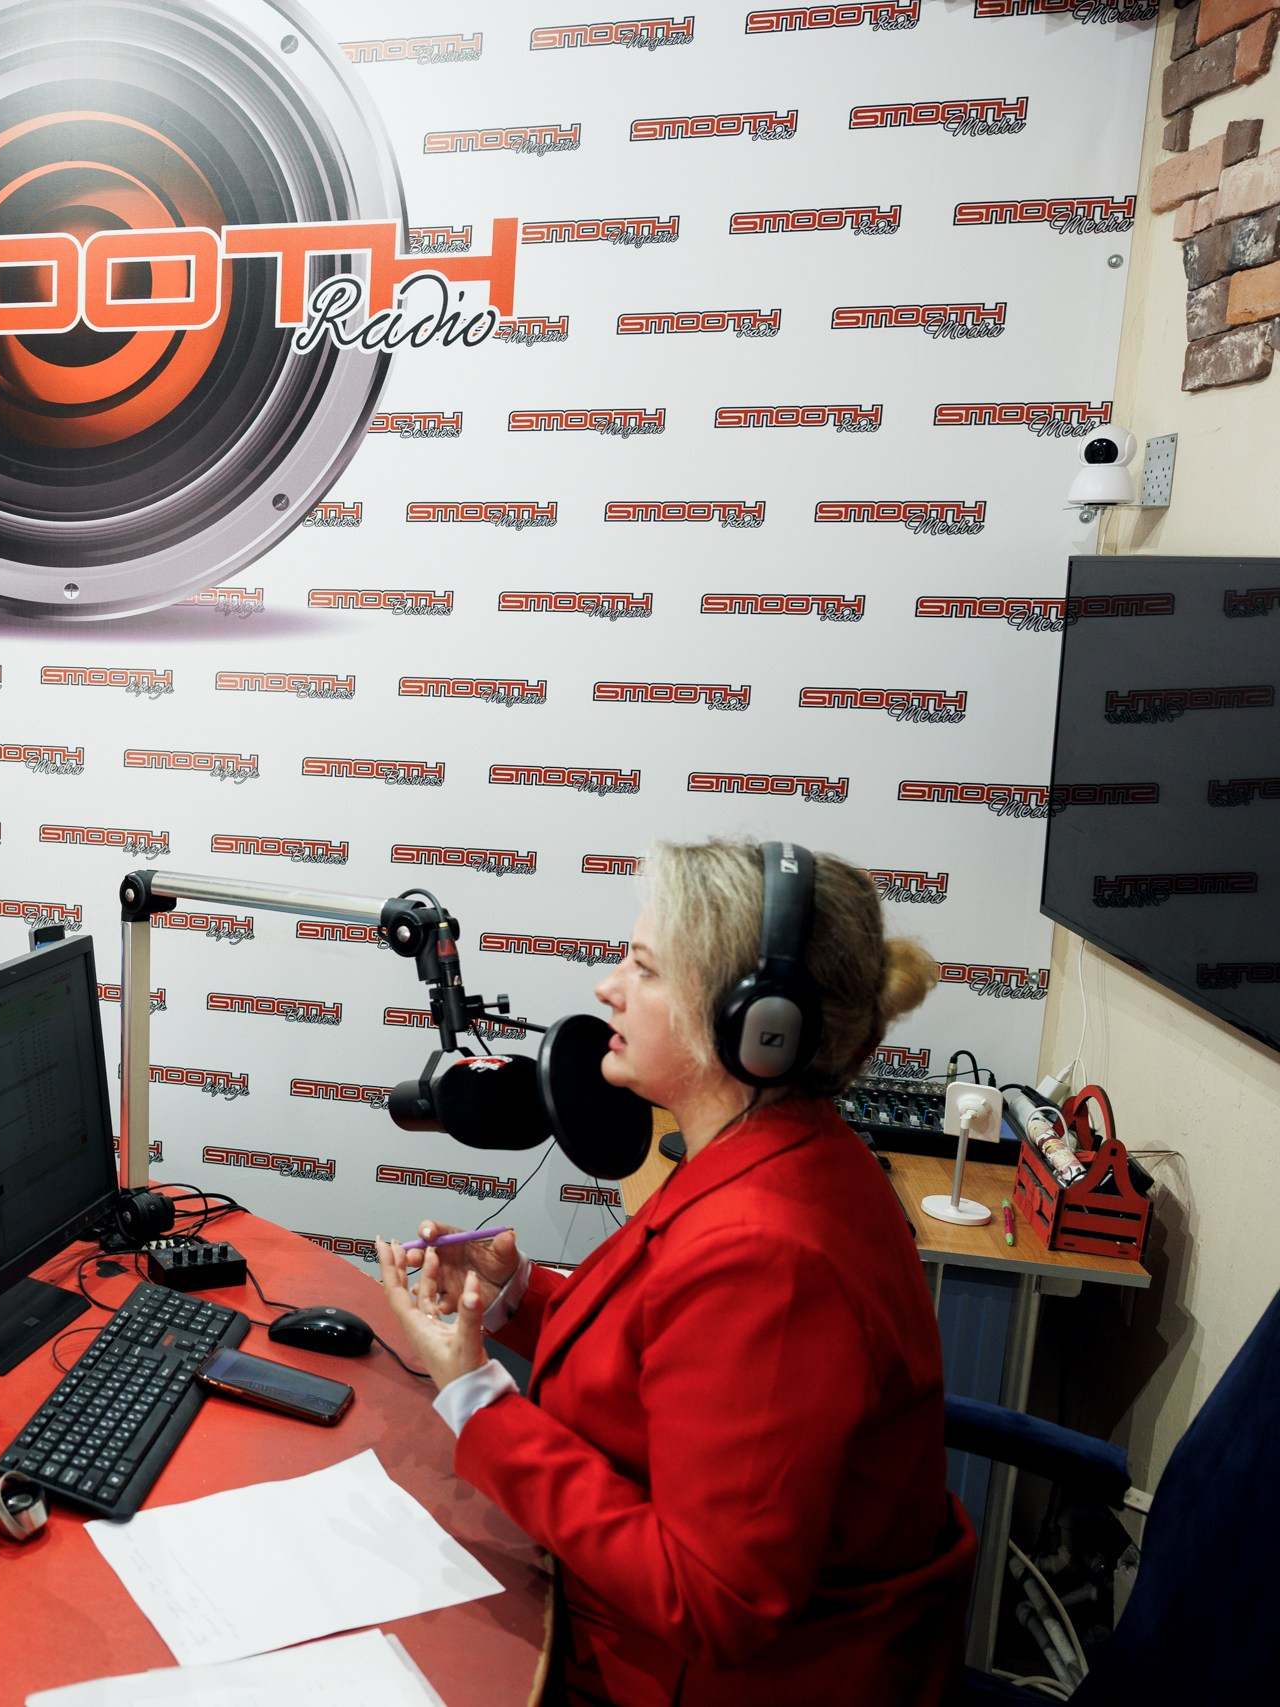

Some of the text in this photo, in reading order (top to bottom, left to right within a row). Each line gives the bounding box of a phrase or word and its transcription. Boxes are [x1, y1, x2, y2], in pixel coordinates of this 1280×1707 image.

[745, 0, 921, 35] SMOOTH
[872, 13, 917, 31] Radio
[530, 15, 694, 51] SMOOTH
[620, 32, 692, 50] Magazine
[416, 47, 481, 65] Business
[849, 96, 1028, 130] SMOOTH
[630, 109, 798, 142] SMOOTH
[751, 123, 794, 140] Radio
[943, 113, 1026, 136] Media
[423, 123, 581, 154] SMOOTH
[510, 137, 579, 156] Magazine
[729, 205, 901, 235] SMOOTH
[953, 195, 1137, 226] SMOOTH
[522, 215, 680, 244] SMOOTH
[853, 218, 897, 235] Radio
[1049, 211, 1135, 234] Media
[409, 237, 470, 254] Business
[609, 229, 678, 248] Magazine
[295, 273, 496, 349] Radio
[616, 309, 781, 335] SMOOTH
[831, 302, 1007, 329] SMOOTH
[735, 322, 777, 337] Radio
[923, 316, 1005, 338] Media
[368, 412, 463, 433] OOTH
[508, 408, 666, 432] SMOOTH
[714, 404, 883, 428] SMOOTH
[836, 417, 879, 432] Radio
[933, 401, 1113, 426] SMOOTH
[399, 421, 461, 438] Business
[595, 419, 664, 438] Magazine
[406, 502, 557, 522] SMOOTH
[489, 512, 555, 530] Magazine
[604, 501, 765, 522] SMOOTH
[720, 513, 761, 528] Radio
[814, 501, 986, 523] SMOOTH
[904, 513, 984, 535] Media
[308, 589, 454, 610] SMOOTH
[392, 599, 453, 614] Business
[498, 591, 653, 613] SMOOTH
[700, 593, 865, 615] SMOOTH
[583, 602, 651, 621] Magazine
[819, 607, 861, 621] Radio
[40, 666, 173, 688] SMOOTH
[215, 671, 355, 694] SMOOTH
[398, 677, 547, 699] SMOOTH
[296, 683, 354, 698] Business
[480, 688, 545, 707] Magazine
[593, 681, 751, 705] SMOOTH
[799, 687, 967, 712] SMOOTH
[707, 696, 747, 710] Radio
[887, 700, 965, 723] Media
[24, 755, 82, 774] Media
[124, 749, 258, 773] SMOOTH
[302, 757, 445, 781] SMOOTH
[385, 769, 444, 785] Business
[488, 764, 641, 790] SMOOTH
[572, 777, 639, 796] Magazine
[687, 772, 849, 797] SMOOTH
[804, 788, 845, 803] Radio
[39, 824, 169, 849] SMOOTH
[211, 834, 349, 860] SMOOTH
[291, 847, 348, 863] Business
[391, 844, 537, 870] SMOOTH
[471, 858, 535, 876] Magazine
[150, 911, 254, 933] MOOTH
[479, 932, 628, 961] SMOOTH
[969, 976, 1048, 1000] Media
[206, 992, 342, 1021] SMOOTH
[285, 1008, 341, 1024] Business
[149, 1065, 249, 1092] MOOTH
[202, 1145, 336, 1177] SMOOTH
[279, 1163, 335, 1180] Business
[376, 1164, 517, 1197] SMOOTH
[454, 1182, 515, 1200] Magazine
